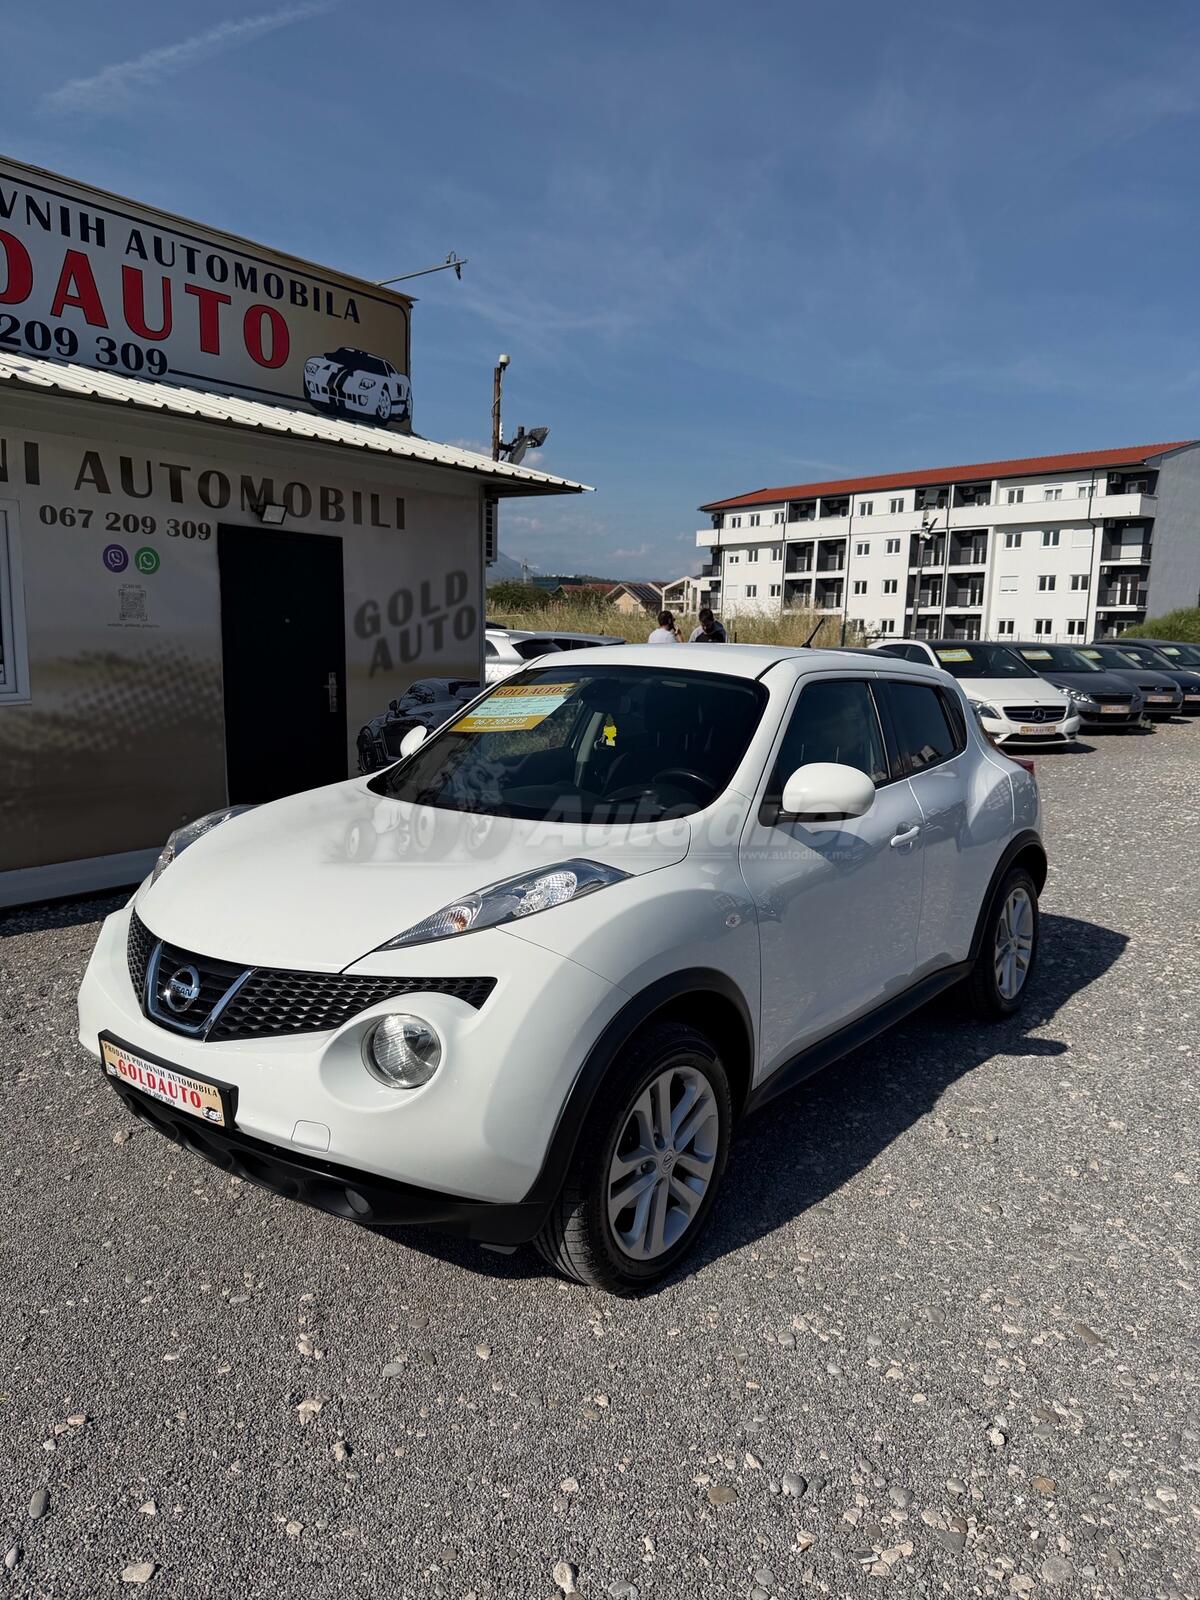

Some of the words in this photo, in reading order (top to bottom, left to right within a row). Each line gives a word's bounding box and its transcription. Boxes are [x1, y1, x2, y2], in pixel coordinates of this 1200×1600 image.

[125, 229, 361, 324] AUTOMOBILA
[95, 336, 169, 376] 309
[74, 450, 406, 530] AUTOMOBILI
[39, 504, 94, 529] 067
[105, 512, 157, 535] 209
[166, 518, 211, 541] 309
[353, 570, 468, 640] GOLD
[369, 605, 477, 679] AUTO
[495, 688, 529, 697] GOLD
[530, 686, 562, 695] AUTO
[104, 1042, 131, 1063] PRODAJA
[168, 1073, 218, 1098] AUTOMOBILA
[118, 1059, 202, 1108] GOLDAUTO
